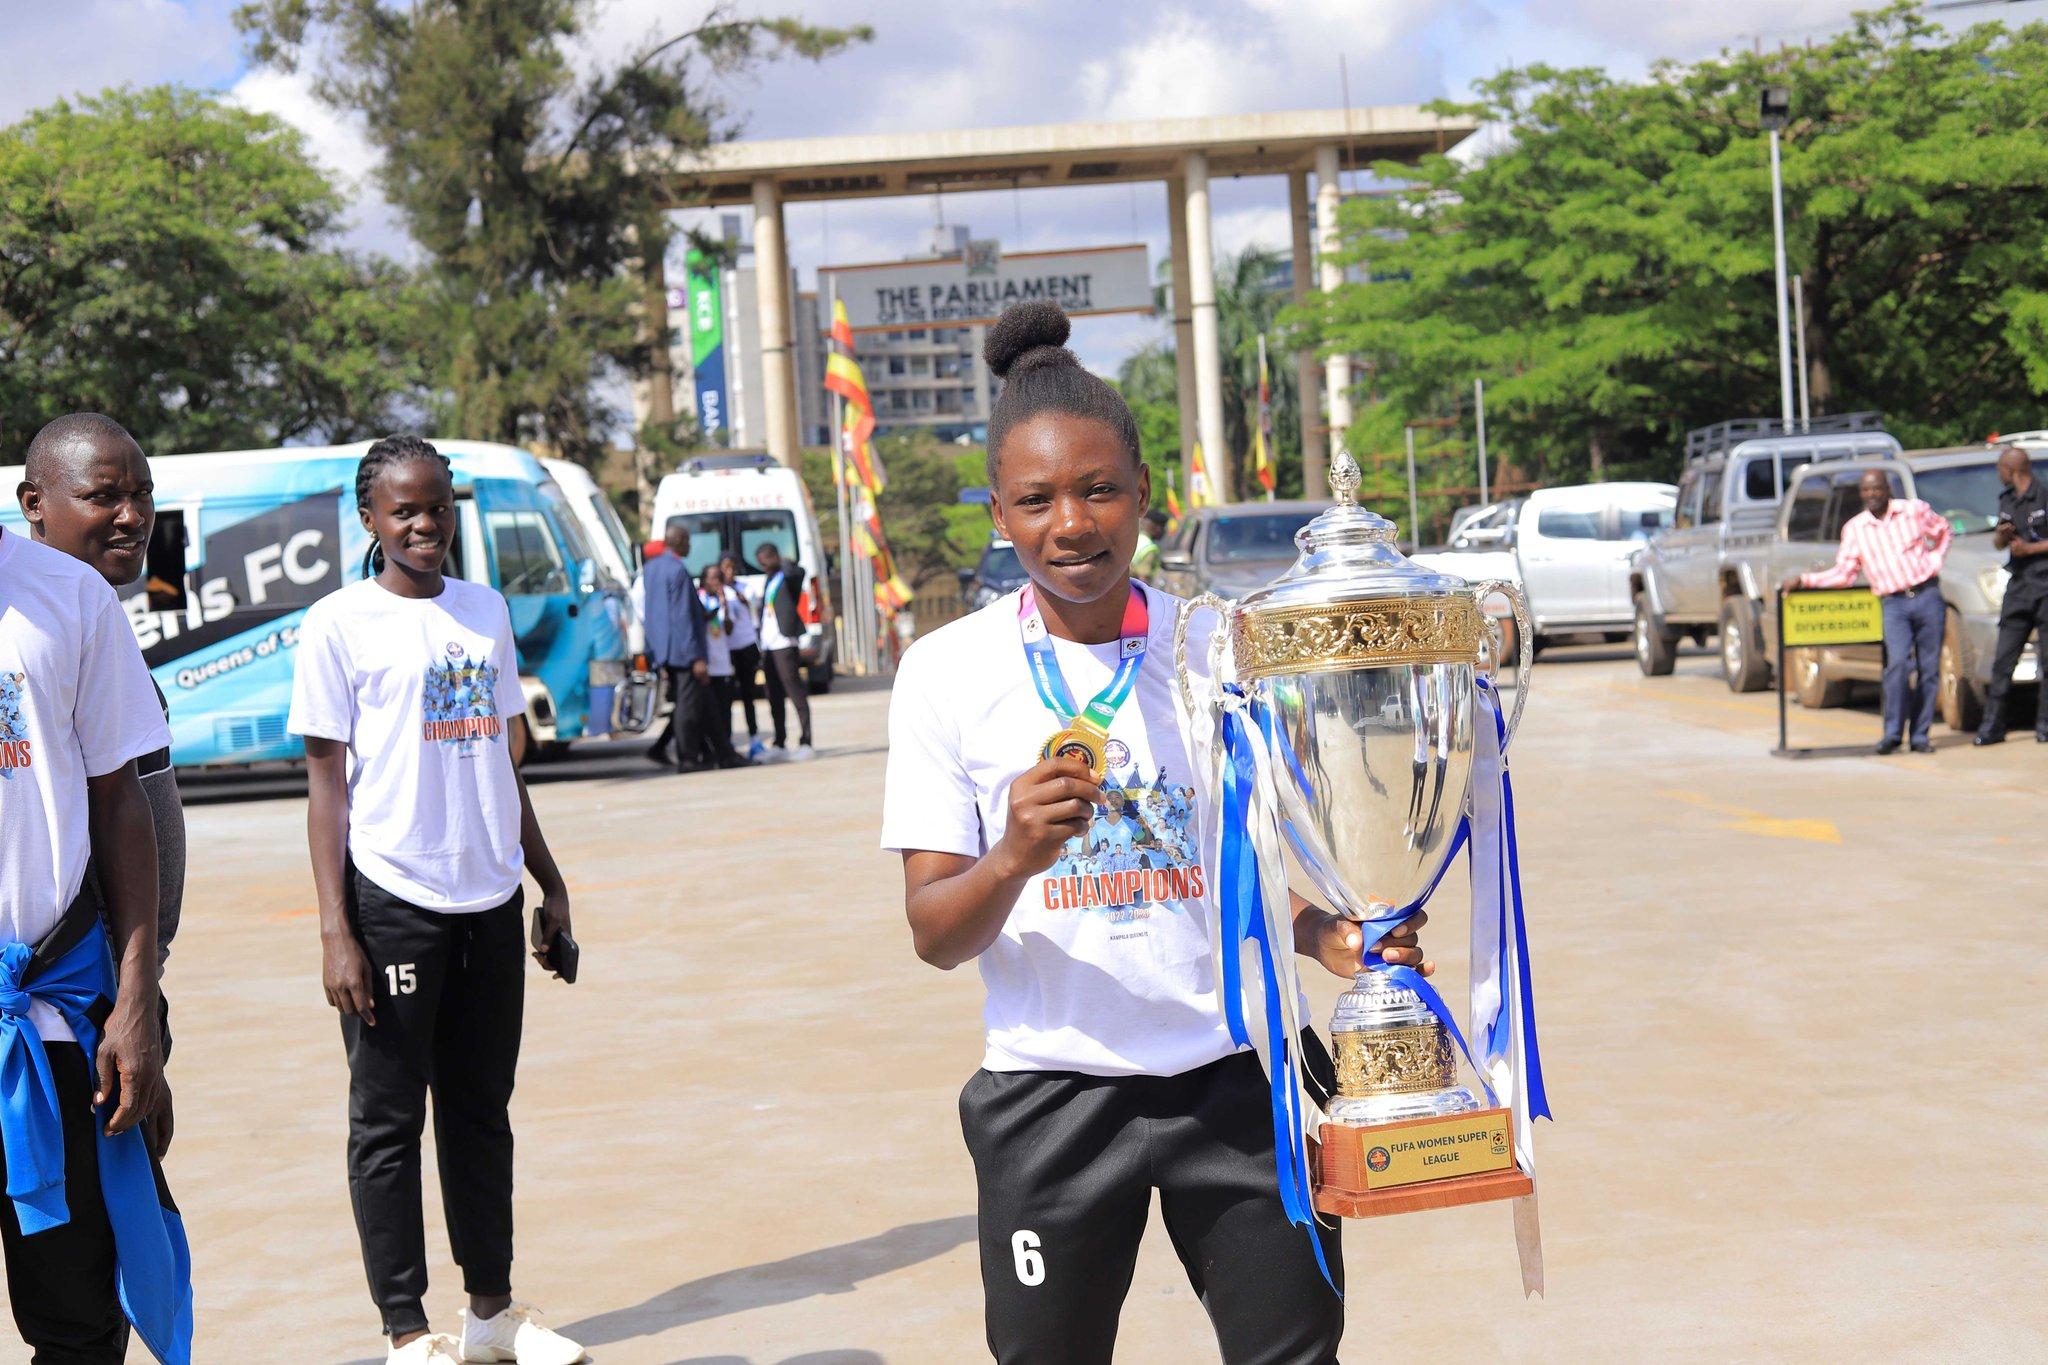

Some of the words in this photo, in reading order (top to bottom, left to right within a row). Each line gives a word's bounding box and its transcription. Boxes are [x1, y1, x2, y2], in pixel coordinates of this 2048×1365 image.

[876, 285, 919, 308] THE
[929, 274, 1092, 305] PARLIAMENT
[701, 389, 721, 438] BAN
[243, 529, 331, 605] FC
[1789, 601, 1874, 614] TEMPORARY
[1794, 620, 1870, 633] DIVERSION
[176, 646, 255, 690] Queens
[255, 631, 278, 657] of
[0, 740, 31, 768] NS
[1043, 865, 1205, 911] CHAMPIONS
[384, 963, 417, 996] 15
[1390, 1142, 1416, 1153] FUFA
[1417, 1135, 1456, 1149] WOMEN
[1457, 1131, 1488, 1144] SUPER
[1423, 1152, 1460, 1166] LEAGUE
[1011, 1229, 1046, 1287] 6
